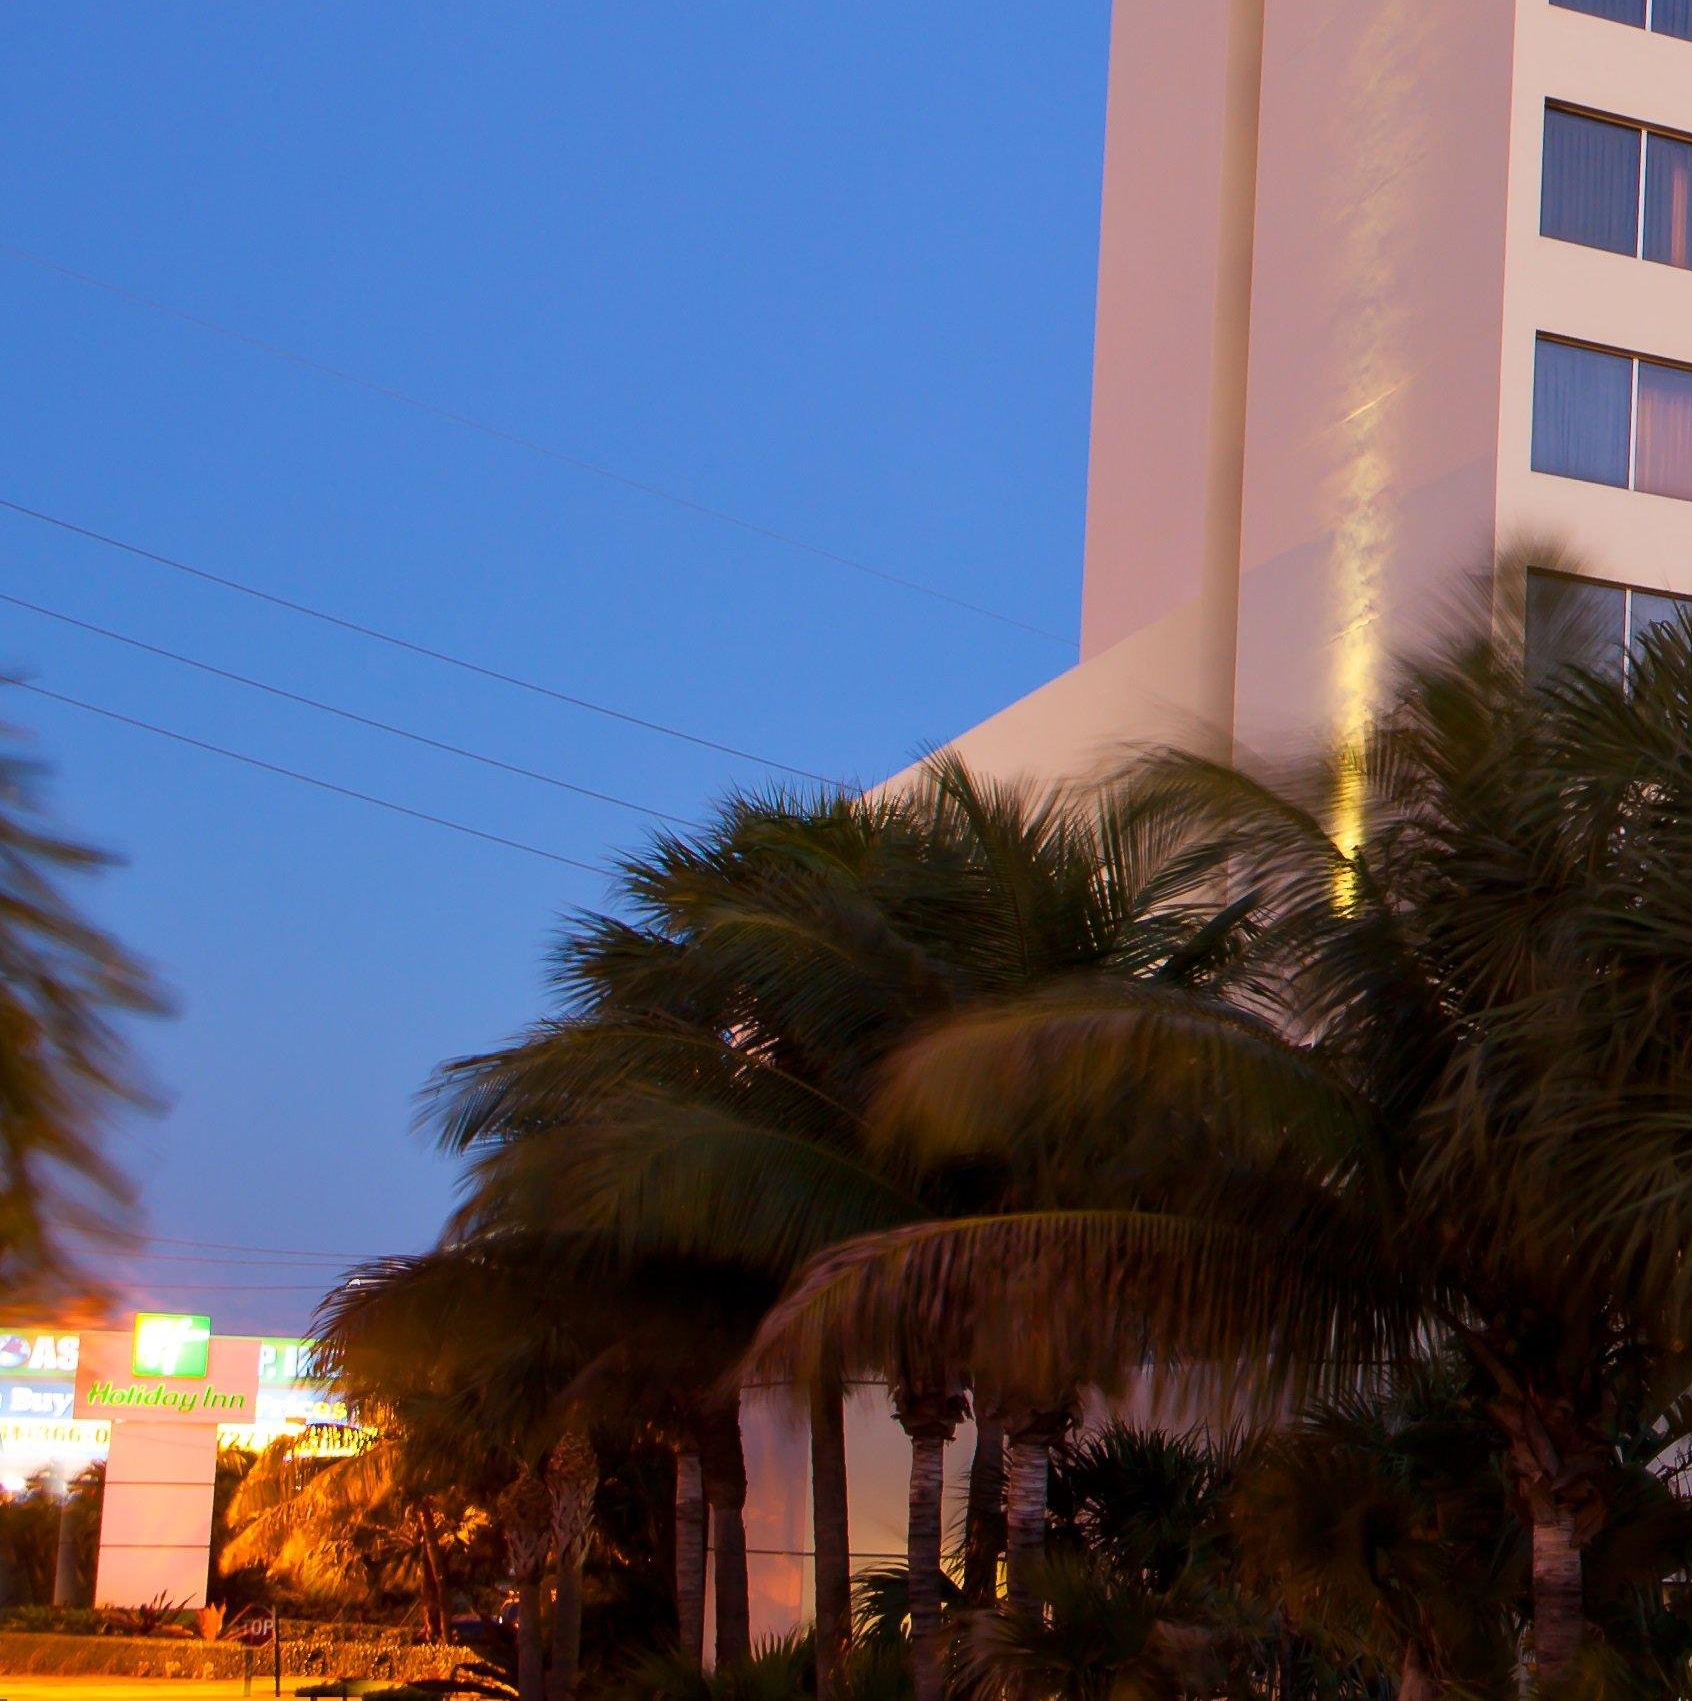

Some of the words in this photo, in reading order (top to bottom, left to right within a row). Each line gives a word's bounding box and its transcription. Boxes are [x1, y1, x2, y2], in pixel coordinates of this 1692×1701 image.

[10, 1386, 74, 1418] Buy
[88, 1381, 197, 1412] Holiday
[202, 1386, 246, 1409] Inn
